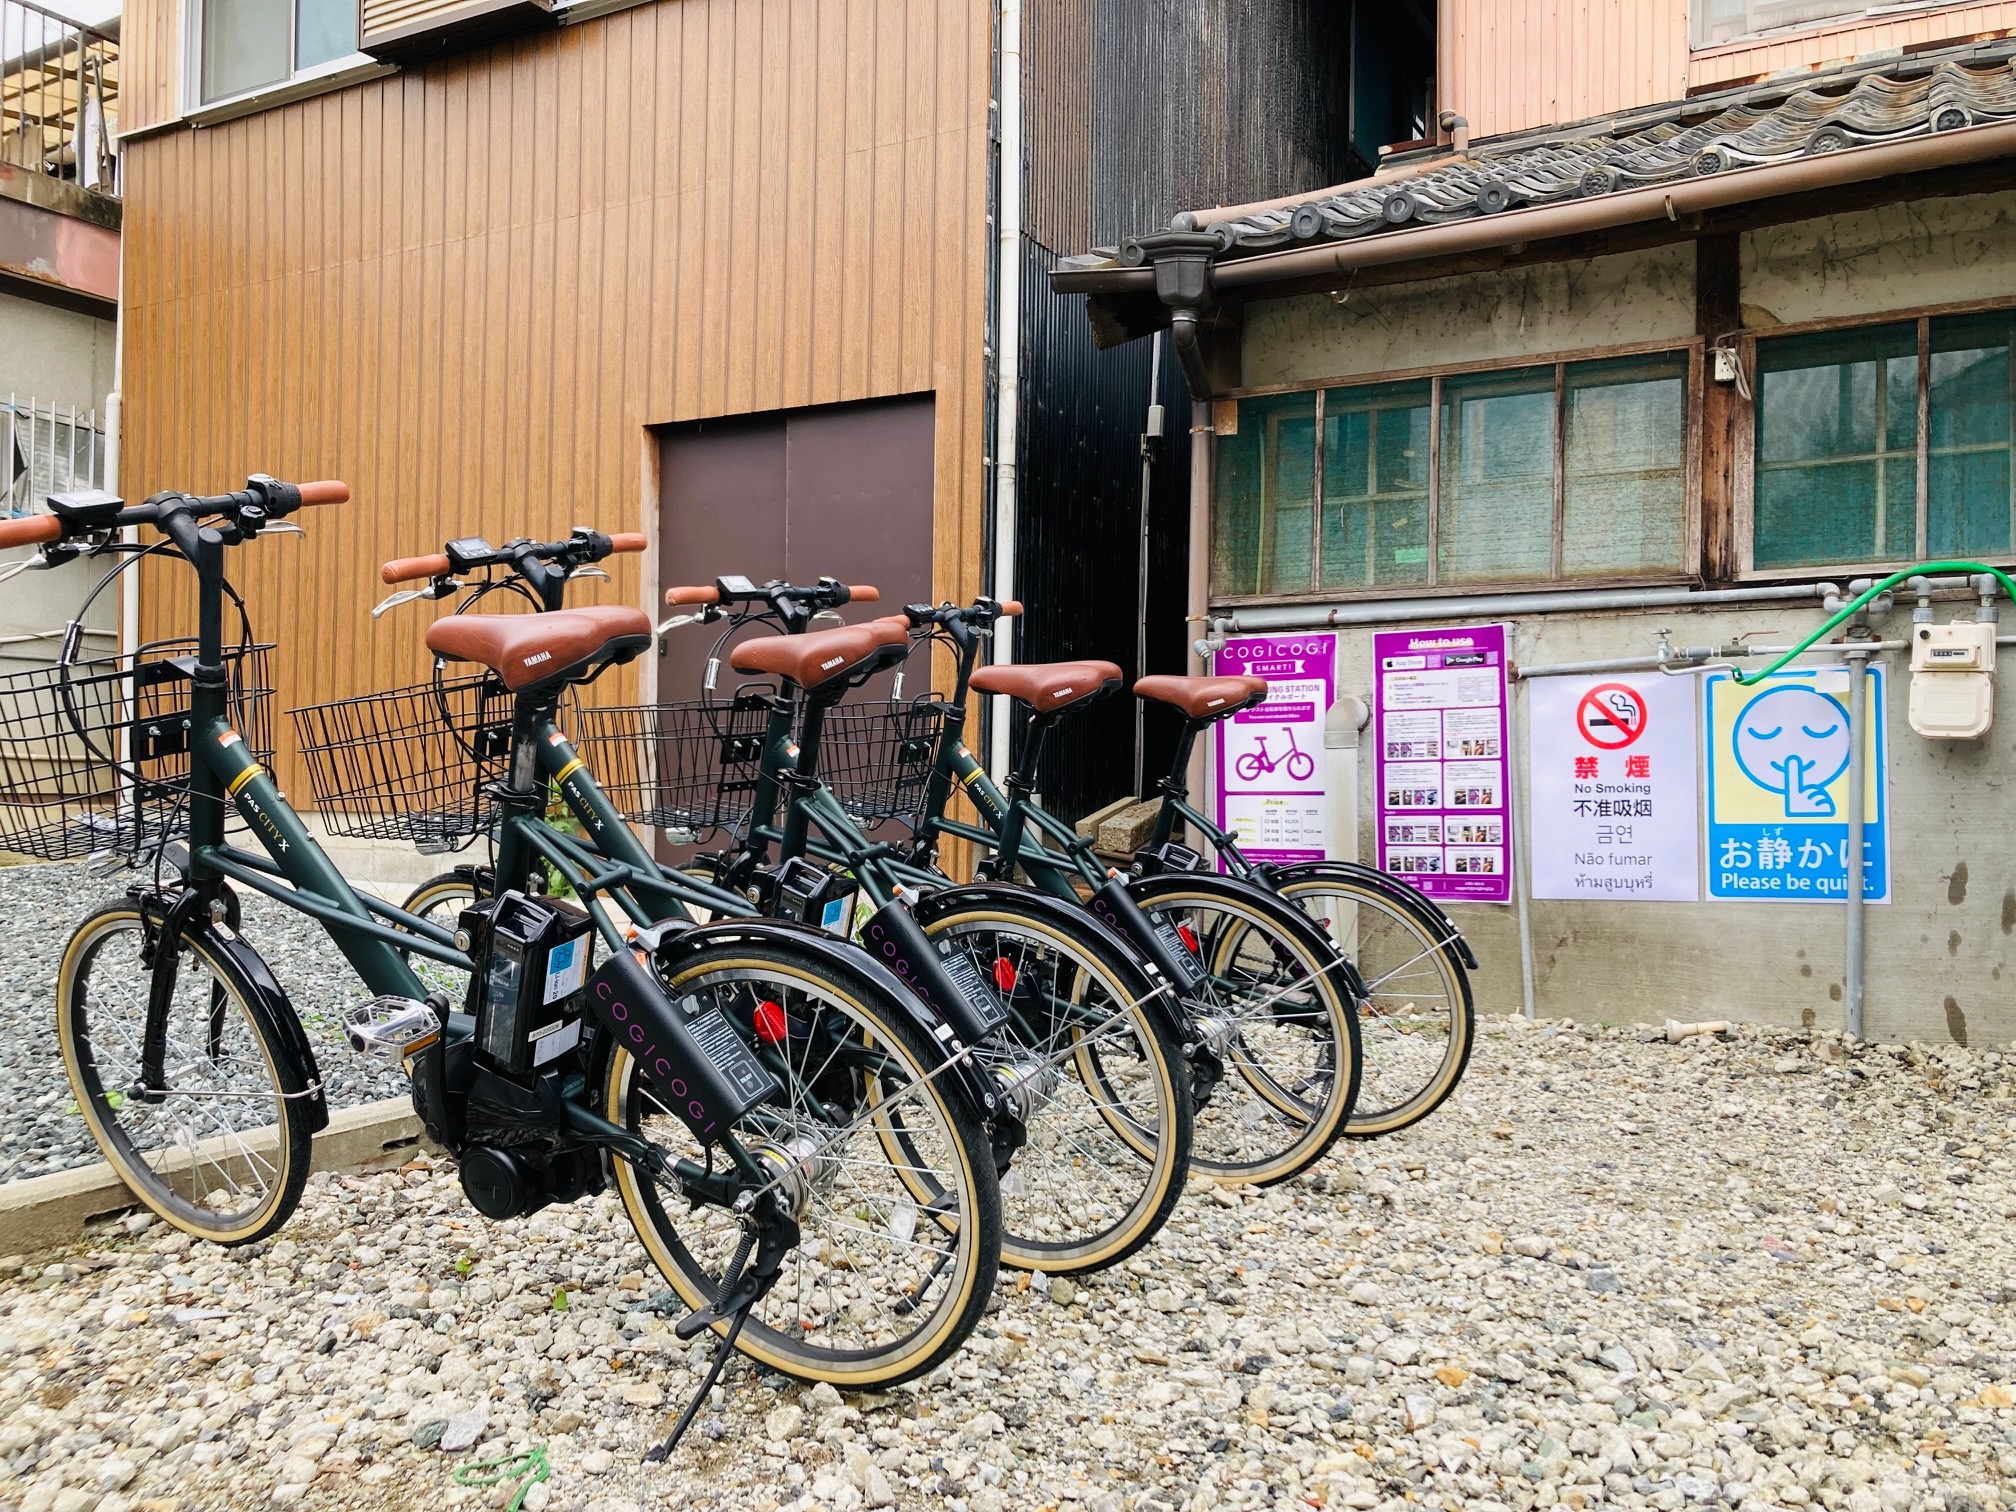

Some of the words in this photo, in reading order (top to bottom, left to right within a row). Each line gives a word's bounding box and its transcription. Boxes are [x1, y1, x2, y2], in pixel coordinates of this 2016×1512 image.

[1223, 642, 1327, 659] COGICOGI
[1409, 638, 1437, 648] How
[1437, 637, 1448, 647] to
[1452, 637, 1474, 647] use
[524, 650, 552, 667] YAMAHA
[820, 656, 844, 670] YAMAHA
[1256, 664, 1292, 672] SMART!
[1285, 684, 1320, 692] STATION
[974, 783, 986, 796] PAS
[1574, 784, 1592, 793] No
[1596, 783, 1651, 795] Smoking
[568, 781, 582, 798] PAS
[580, 798, 598, 820] CITY
[1574, 799, 1652, 818] 不准吸烟
[244, 792, 261, 813] PAS
[258, 812, 282, 841] CITY
[278, 838, 290, 853] X
[1596, 825, 1632, 844] 금연
[1762, 827, 1784, 836] しず
[1574, 852, 1604, 865] Não
[1608, 852, 1652, 865] fumar
[1574, 871, 1653, 892] ห้ามสูบบุหรี่
[1722, 872, 1781, 890] Please
[1786, 872, 1810, 890] be
[1816, 874, 1874, 894] quit.
[596, 982, 716, 1133] COGICOGI
